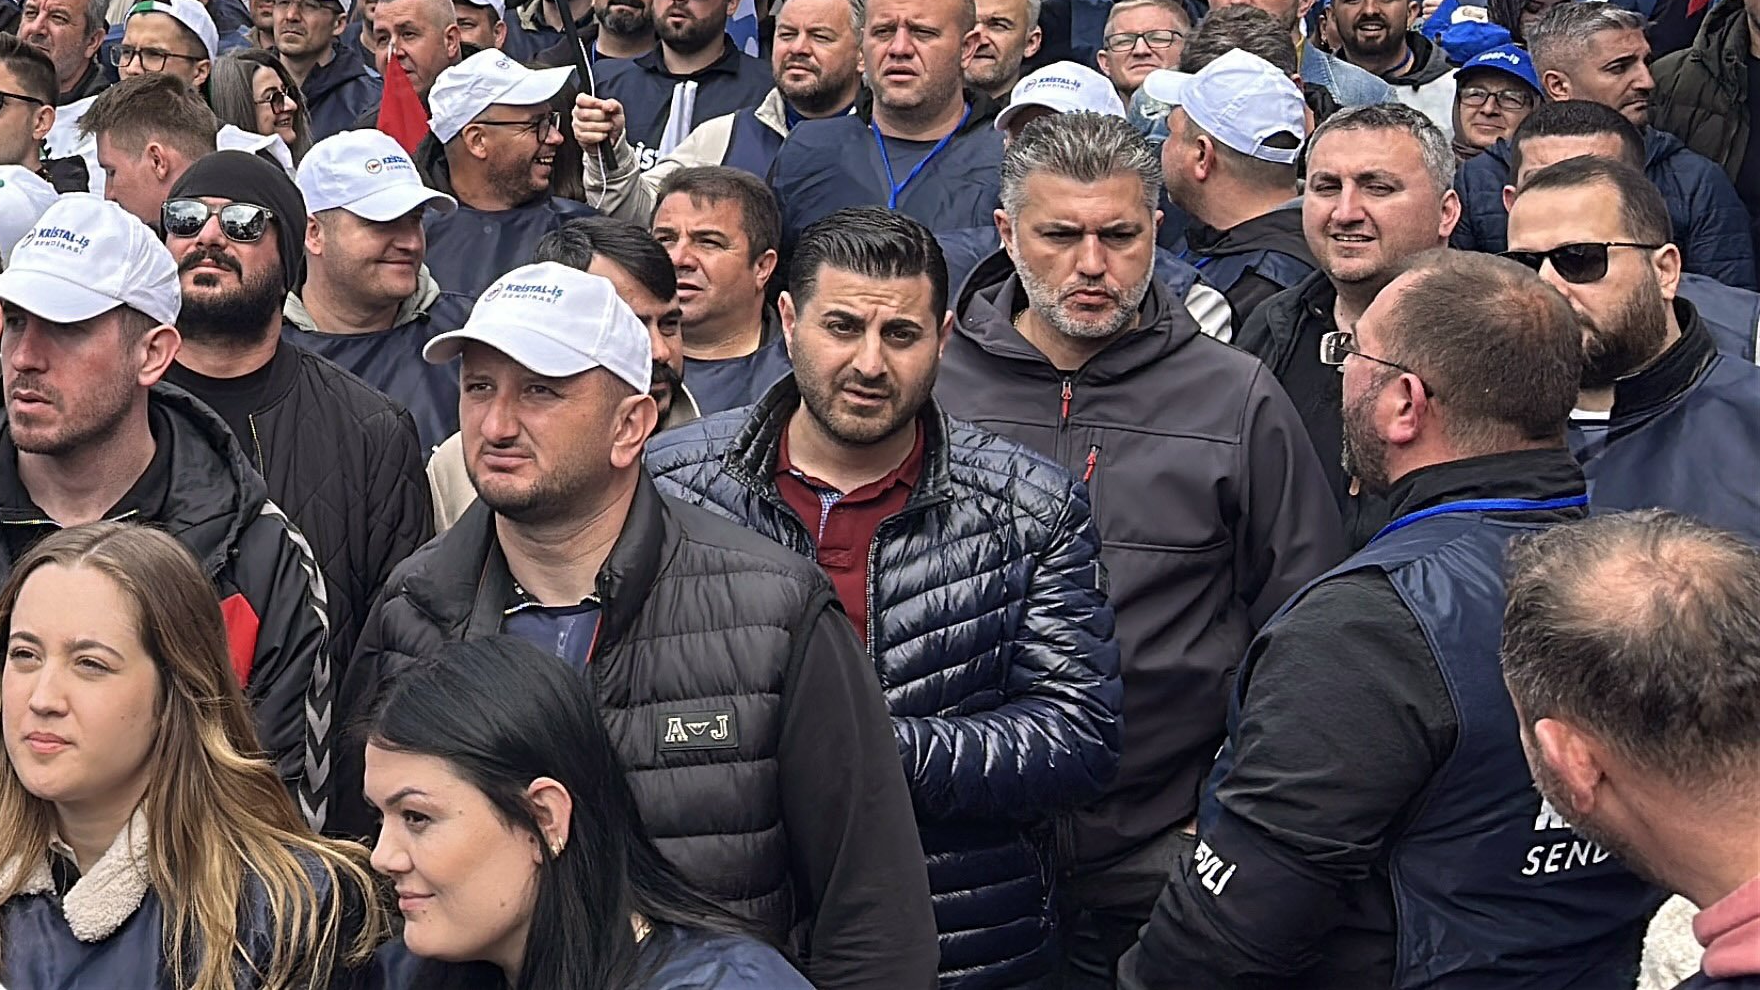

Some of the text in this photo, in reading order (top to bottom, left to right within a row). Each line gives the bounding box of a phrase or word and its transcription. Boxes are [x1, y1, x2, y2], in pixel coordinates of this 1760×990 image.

[1038, 76, 1082, 88] KRİSTAL-İŞ
[37, 226, 90, 250] KRİSTAL-İŞ
[33, 240, 85, 256] SENDİKASI
[501, 292, 558, 305] SENDİKASI
[505, 283, 564, 300] KRİSTAL-İŞ
